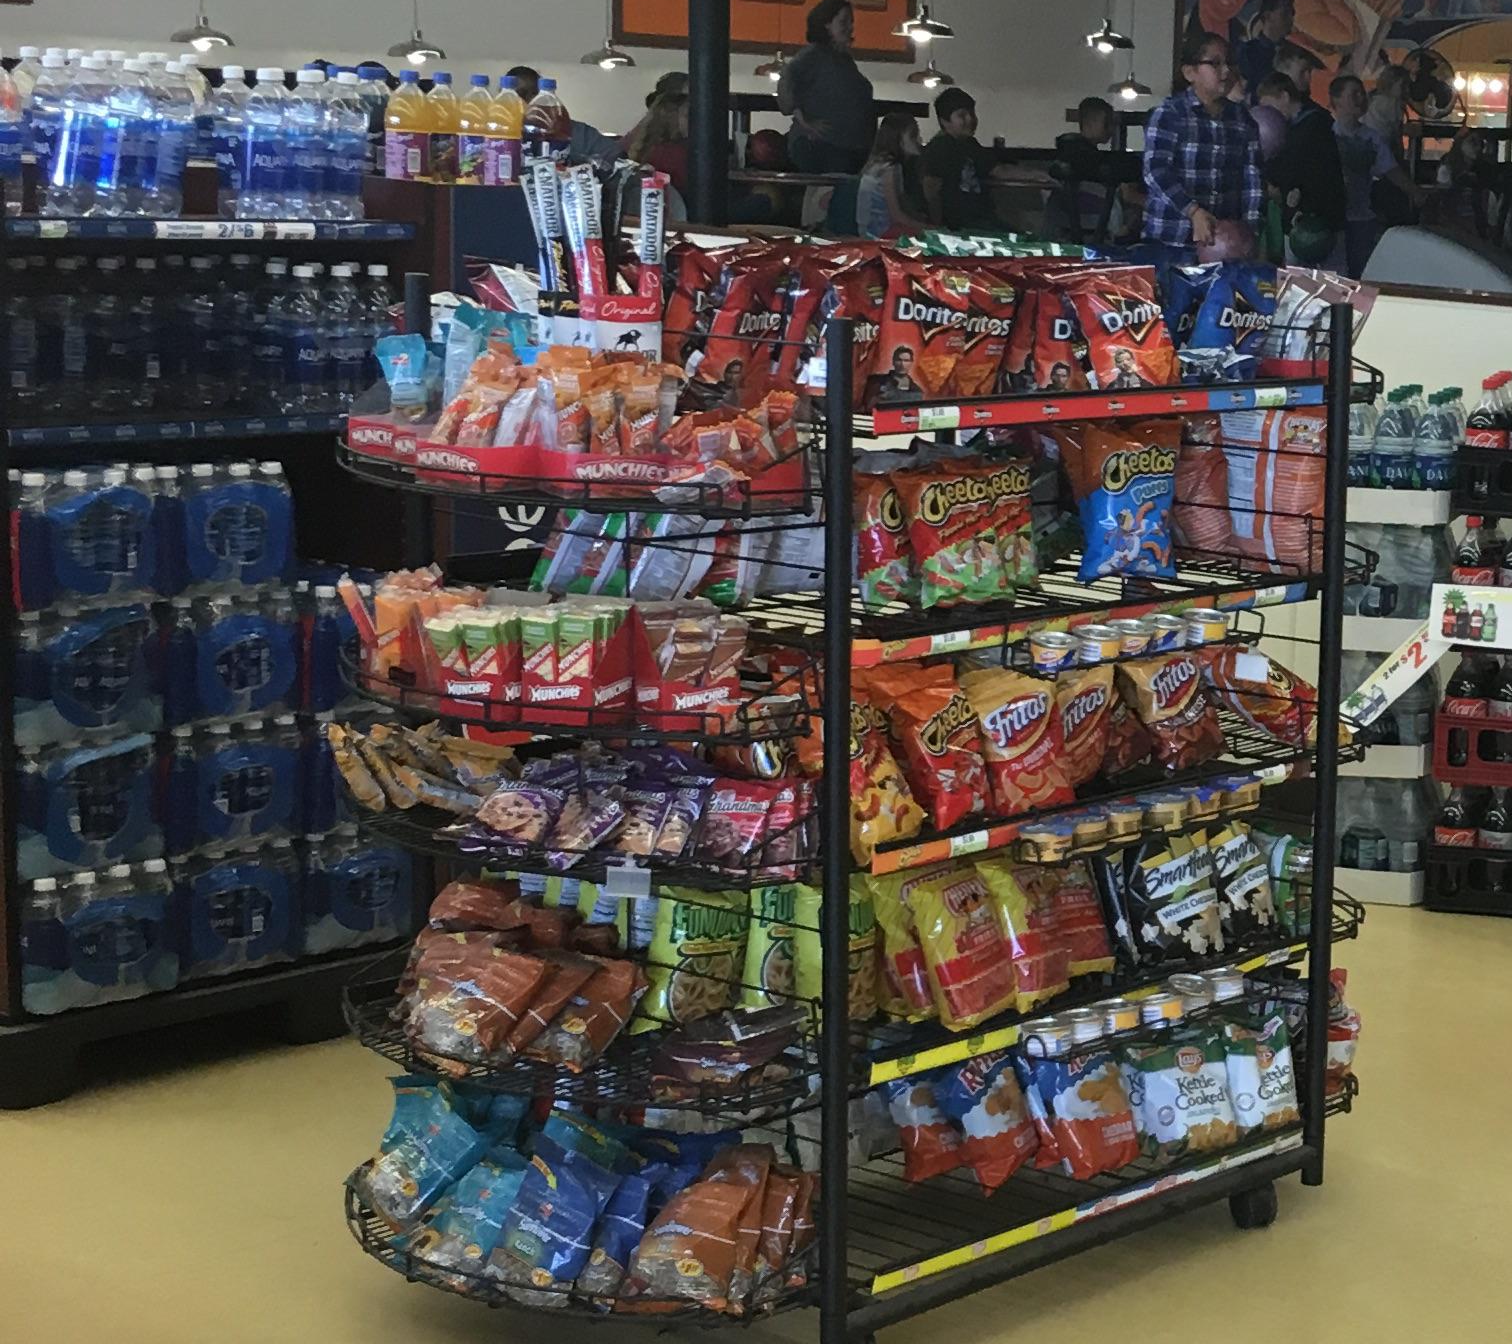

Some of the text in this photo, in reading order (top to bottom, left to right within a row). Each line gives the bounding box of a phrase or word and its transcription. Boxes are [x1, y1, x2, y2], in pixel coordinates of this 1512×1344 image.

[644, 201, 659, 263] MATADOR
[601, 301, 656, 321] Original
[898, 297, 965, 325] Dorito
[1220, 307, 1273, 330] Doritos
[575, 462, 666, 480] MUNCHIES
[1103, 446, 1175, 493] Cheetos
[921, 477, 990, 526] Cheeto
[447, 680, 493, 696] MUNCHIES
[1151, 657, 1197, 705] Fritos
[531, 685, 581, 701] MUNCHIES
[674, 687, 729, 709] MUNCHIES
[921, 694, 976, 753] Cheeto
[984, 692, 1049, 747] Fritos
[1176, 1075, 1215, 1093] Kettle
[1261, 1065, 1290, 1086] ettle
[1176, 1088, 1224, 1110] Cooked
